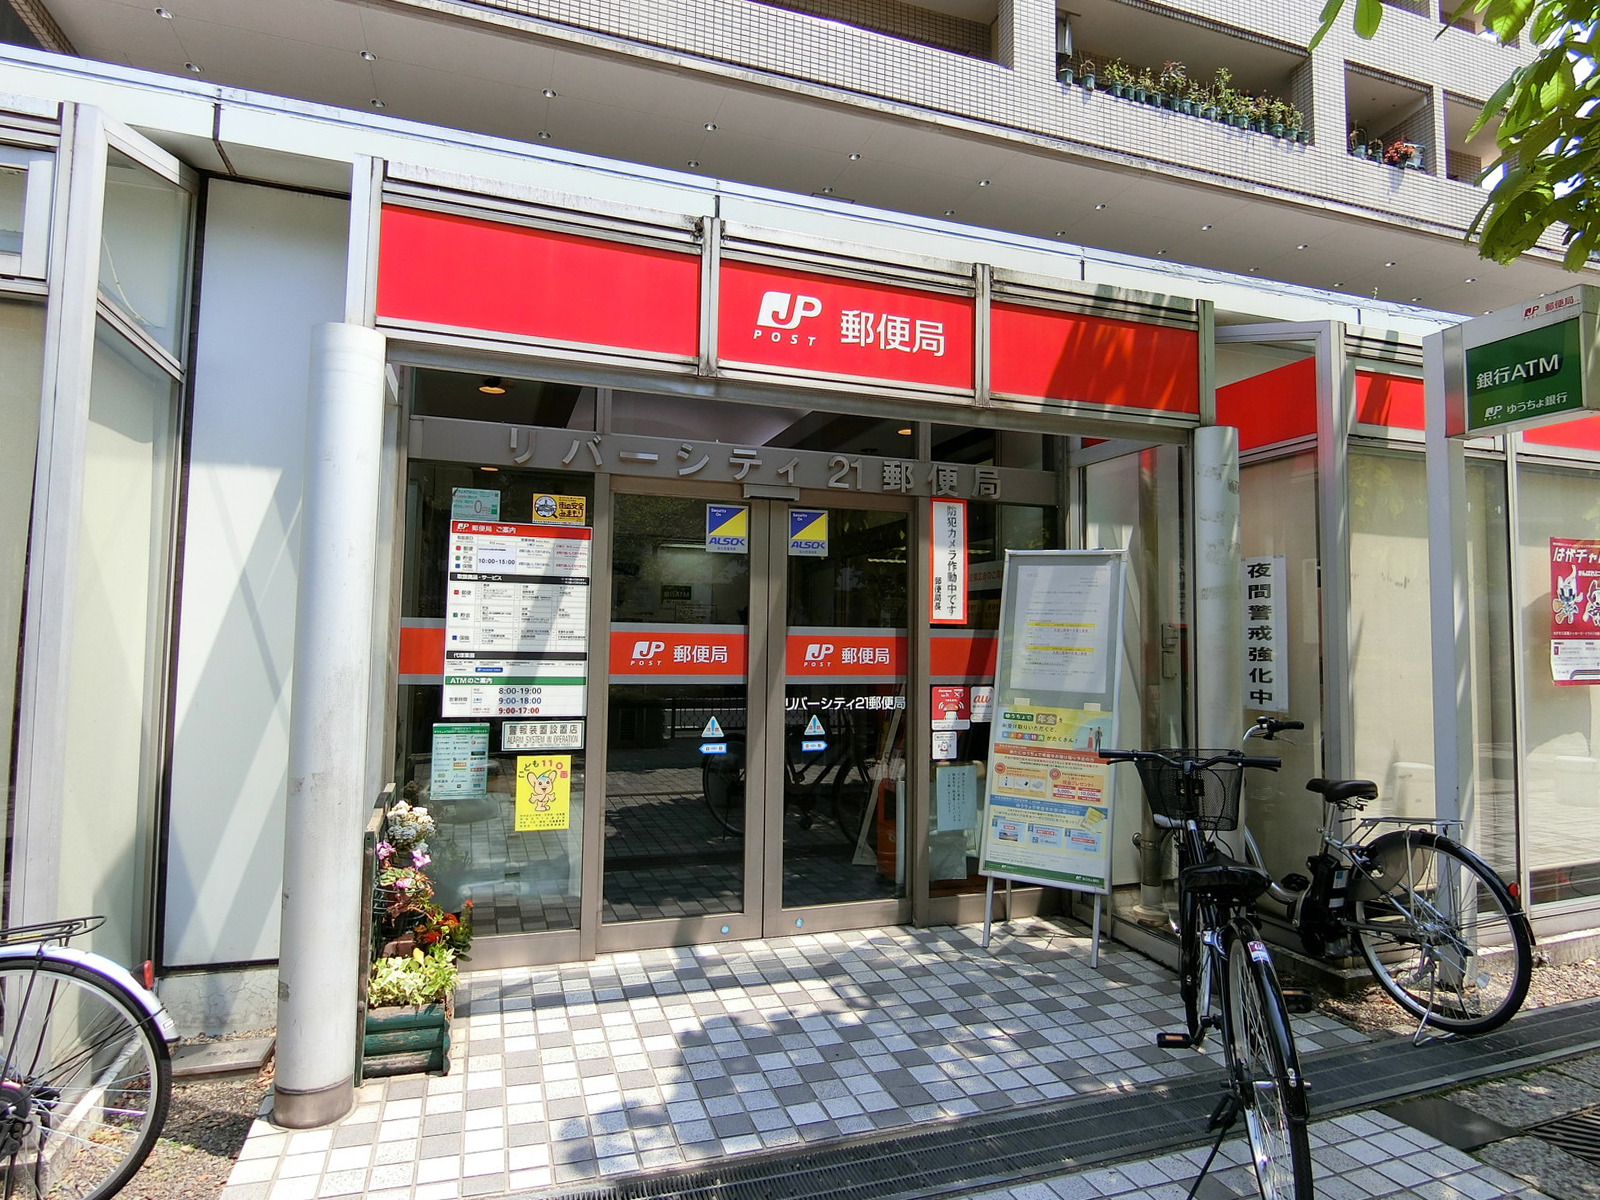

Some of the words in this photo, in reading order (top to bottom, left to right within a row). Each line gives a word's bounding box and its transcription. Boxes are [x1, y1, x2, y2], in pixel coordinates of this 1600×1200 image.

[1545, 296, 1574, 312] 郵便局
[753, 330, 816, 346] POST
[840, 310, 945, 356] 郵便局
[1476, 353, 1559, 389] 銀行ATM
[1507, 391, 1568, 414] ゆうちょ銀行
[510, 427, 1001, 499] リバーシティ21郵便局
[708, 537, 746, 546] ALSOK
[791, 541, 826, 550] ALSOK
[946, 505, 957, 616] 防犯カメラ作動中です
[1553, 547, 1600, 564] はがチャ
[1247, 562, 1273, 705] 夜間警戒強化中
[673, 645, 728, 664] 郵便局
[841, 647, 890, 665] 郵便局
[498, 687, 542, 695] 8:00-19:00
[973, 694, 991, 704] au
[498, 697, 542, 705] 9:00-18:00
[785, 696, 906, 711] リバーシティ21郵便局
[1037, 713, 1056, 724] 年金
[508, 724, 578, 735] 警報装置設置店
[507, 735, 525, 744] ALARM
[525, 735, 546, 744] SYSTEM
[546, 735, 552, 743] IN
[553, 734, 579, 743] OPERATION
